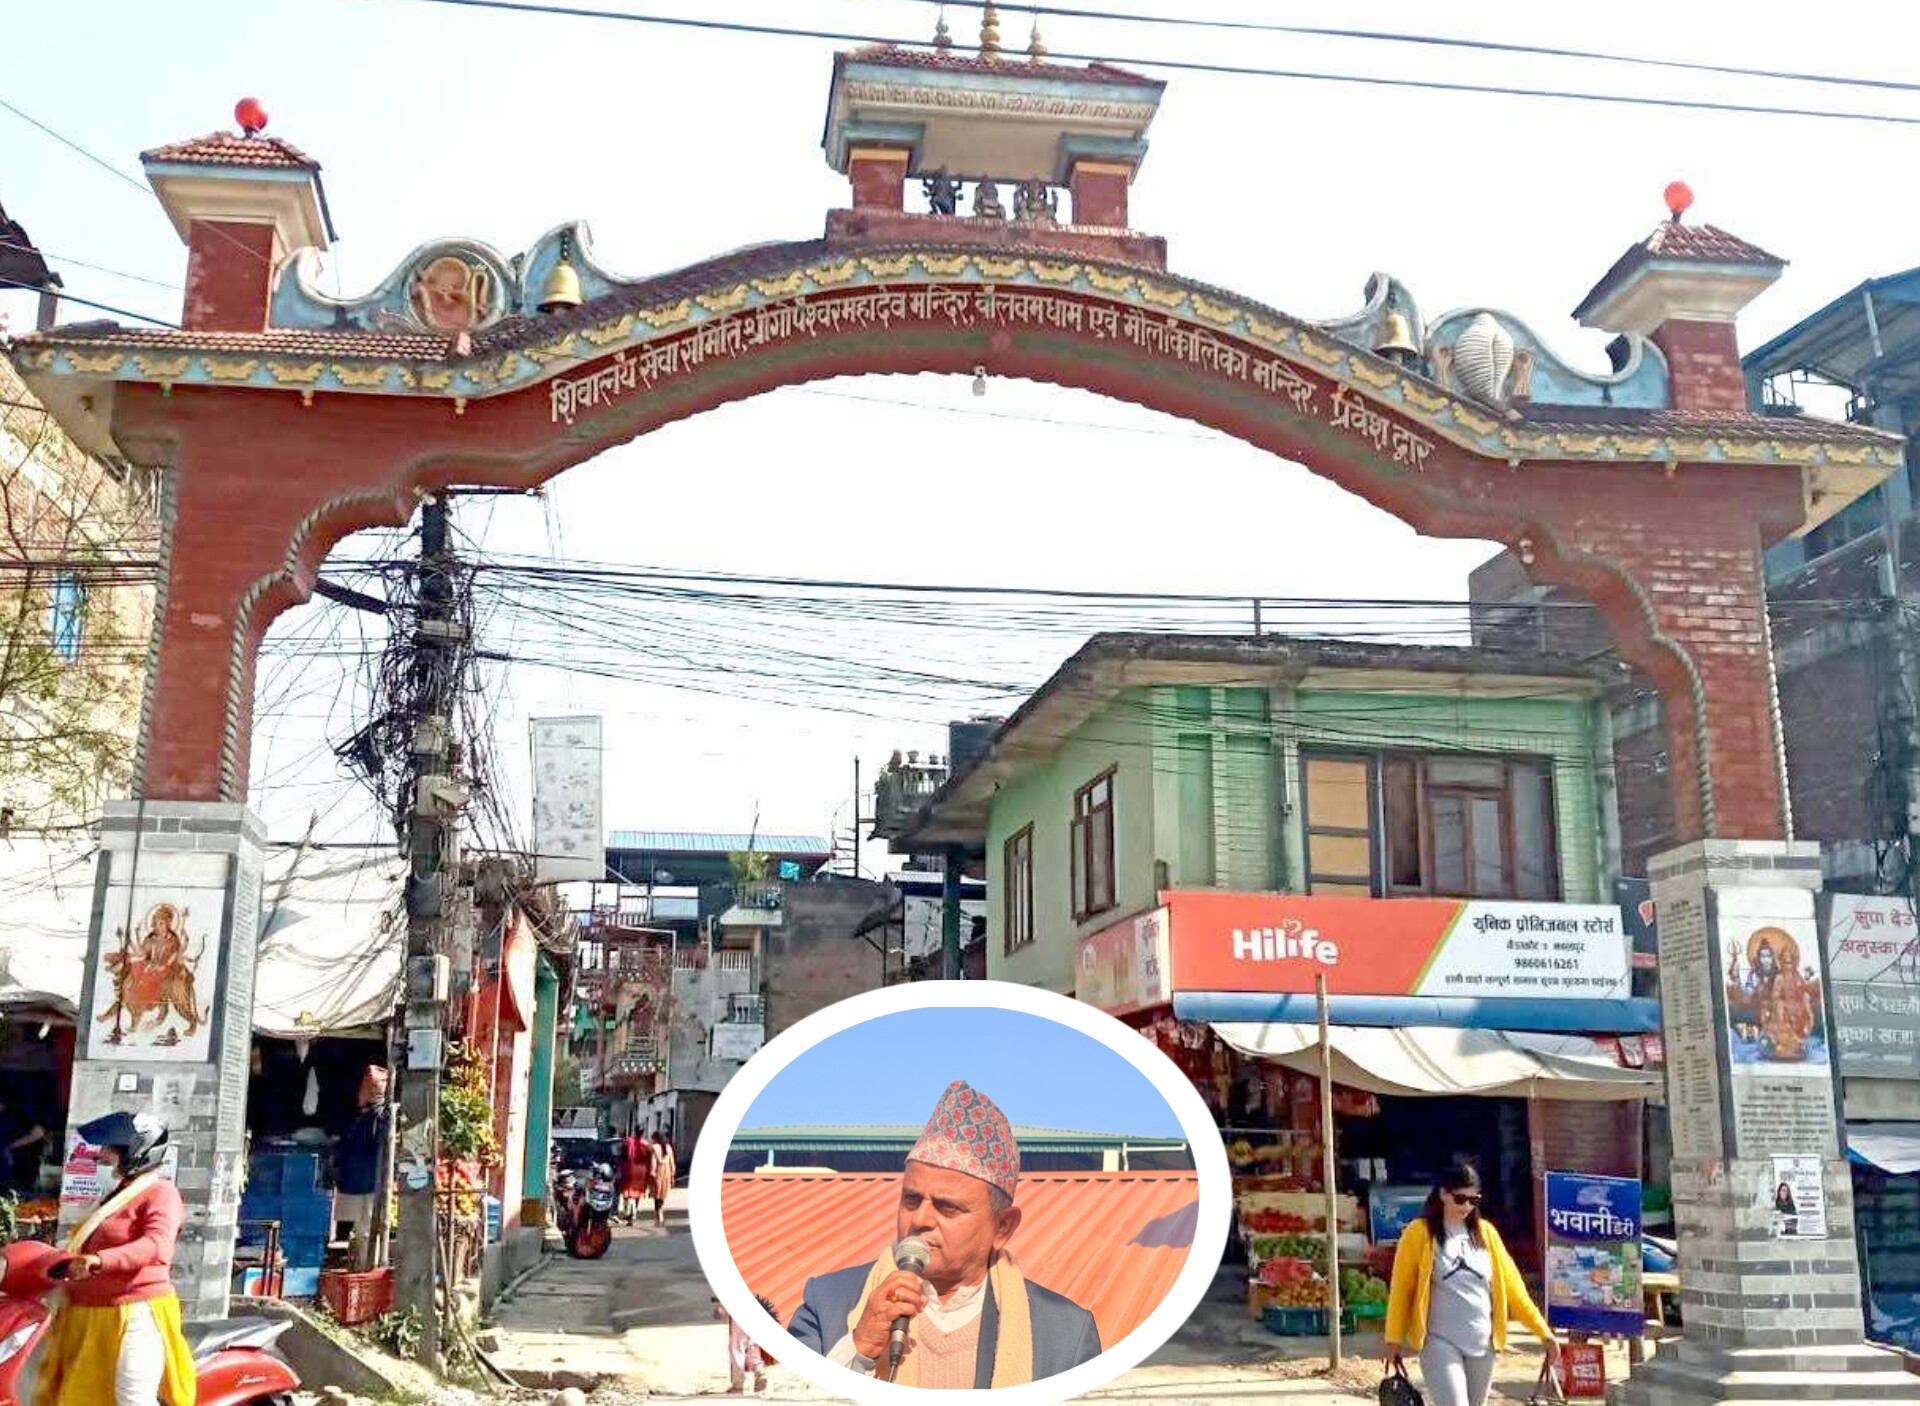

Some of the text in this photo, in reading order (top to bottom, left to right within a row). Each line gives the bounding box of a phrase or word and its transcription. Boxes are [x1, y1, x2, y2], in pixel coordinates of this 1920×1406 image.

[639, 343, 679, 389] सेवा
[1089, 305, 1120, 338] एवं
[1392, 423, 1434, 472] द्वार
[1890, 908, 1916, 928] देउ
[1232, 918, 1339, 965] Hilife
[1550, 1206, 1612, 1235] भवानी
